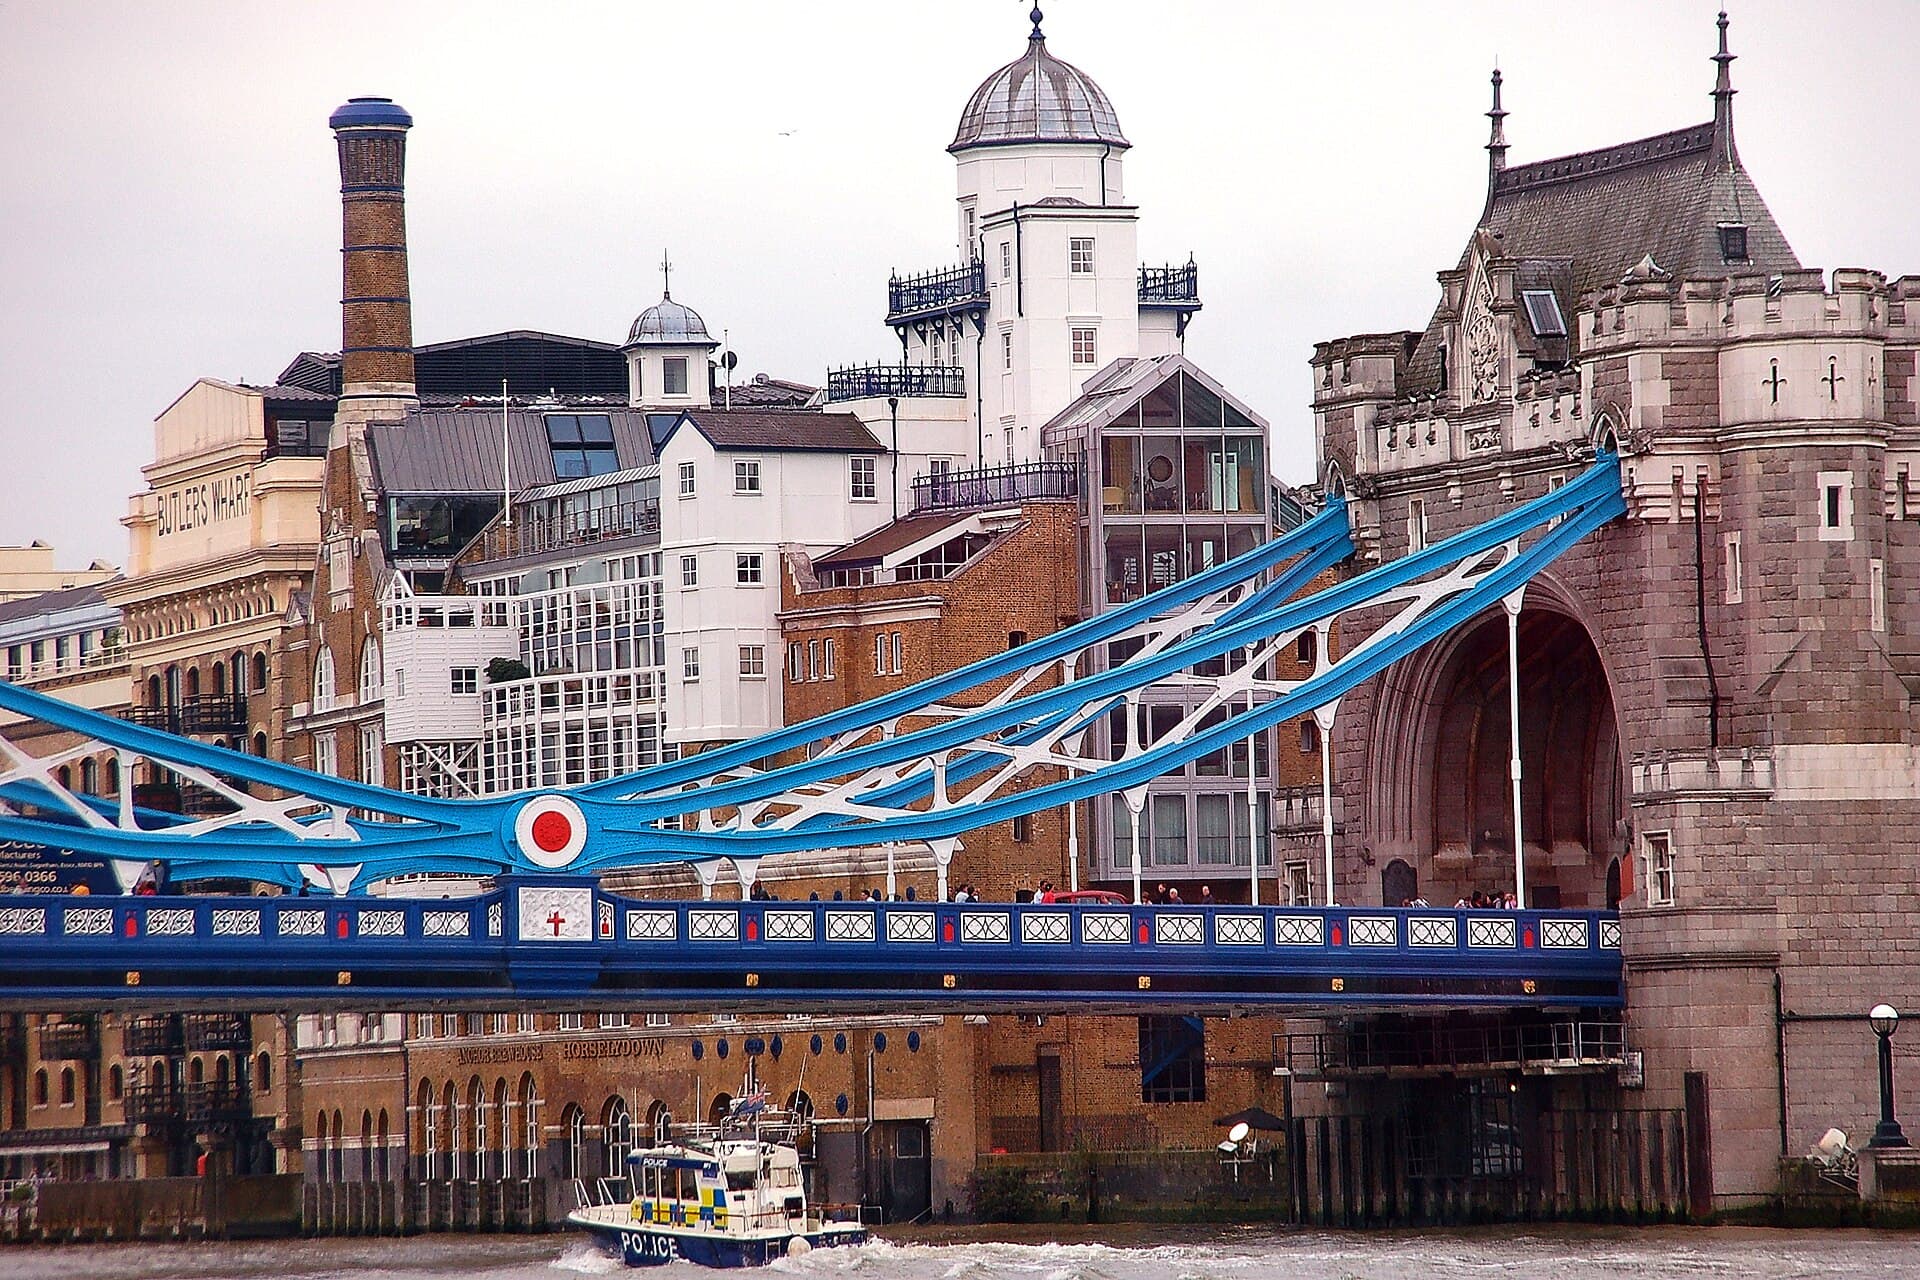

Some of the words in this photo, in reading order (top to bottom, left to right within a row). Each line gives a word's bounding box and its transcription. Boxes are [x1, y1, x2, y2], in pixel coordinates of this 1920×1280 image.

[0, 850, 41, 859] facturers
[24, 870, 57, 882] 0366
[643, 1158, 669, 1168] POLICE
